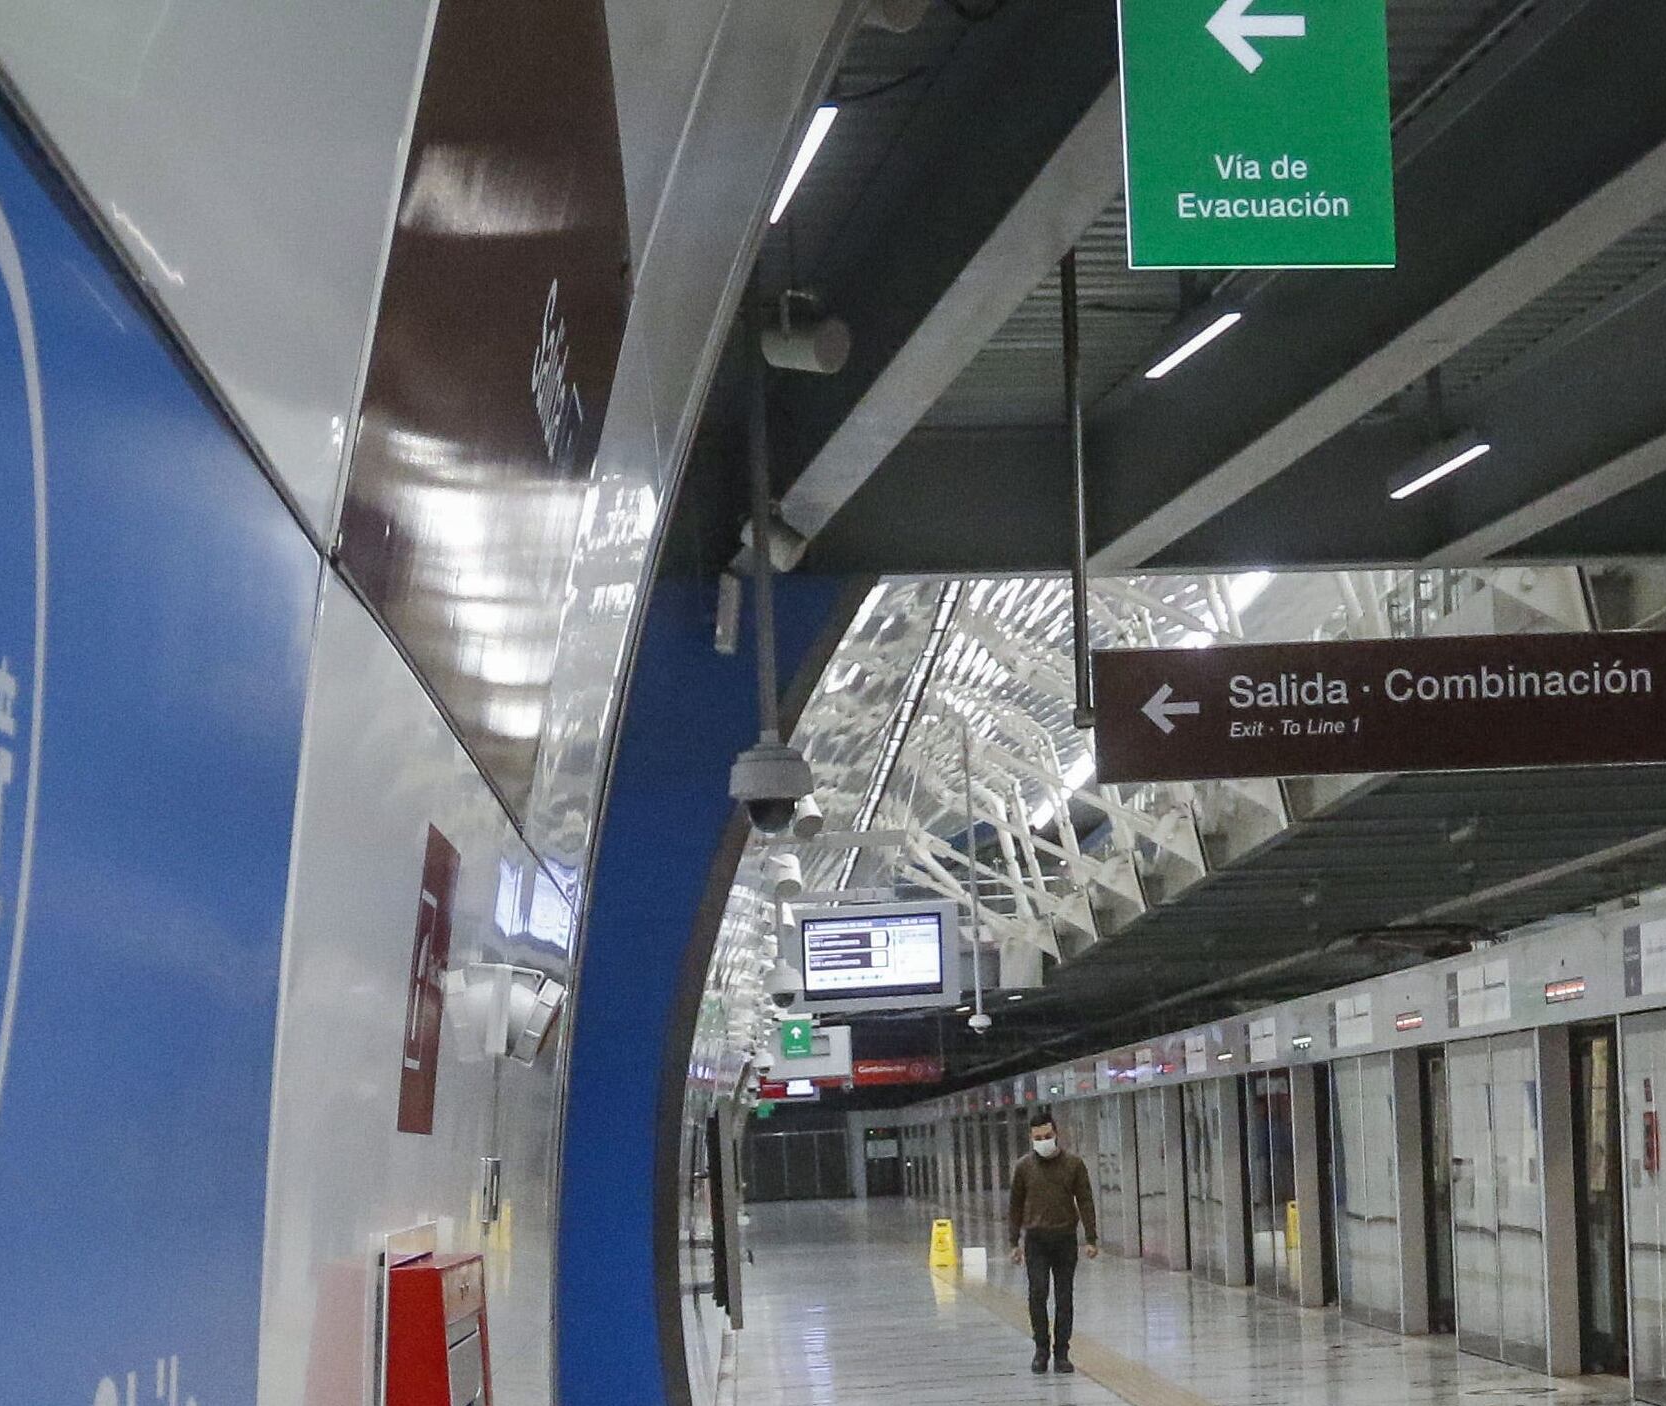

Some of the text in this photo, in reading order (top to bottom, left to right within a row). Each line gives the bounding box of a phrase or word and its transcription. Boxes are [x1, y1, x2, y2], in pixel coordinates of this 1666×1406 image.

[1214, 154, 1308, 180] Vía de
[1177, 191, 1350, 218] Evacuación
[1229, 671, 1350, 709] Salida
[1384, 660, 1652, 702] Combinación
[1229, 717, 1361, 738] Exit To Line 1
